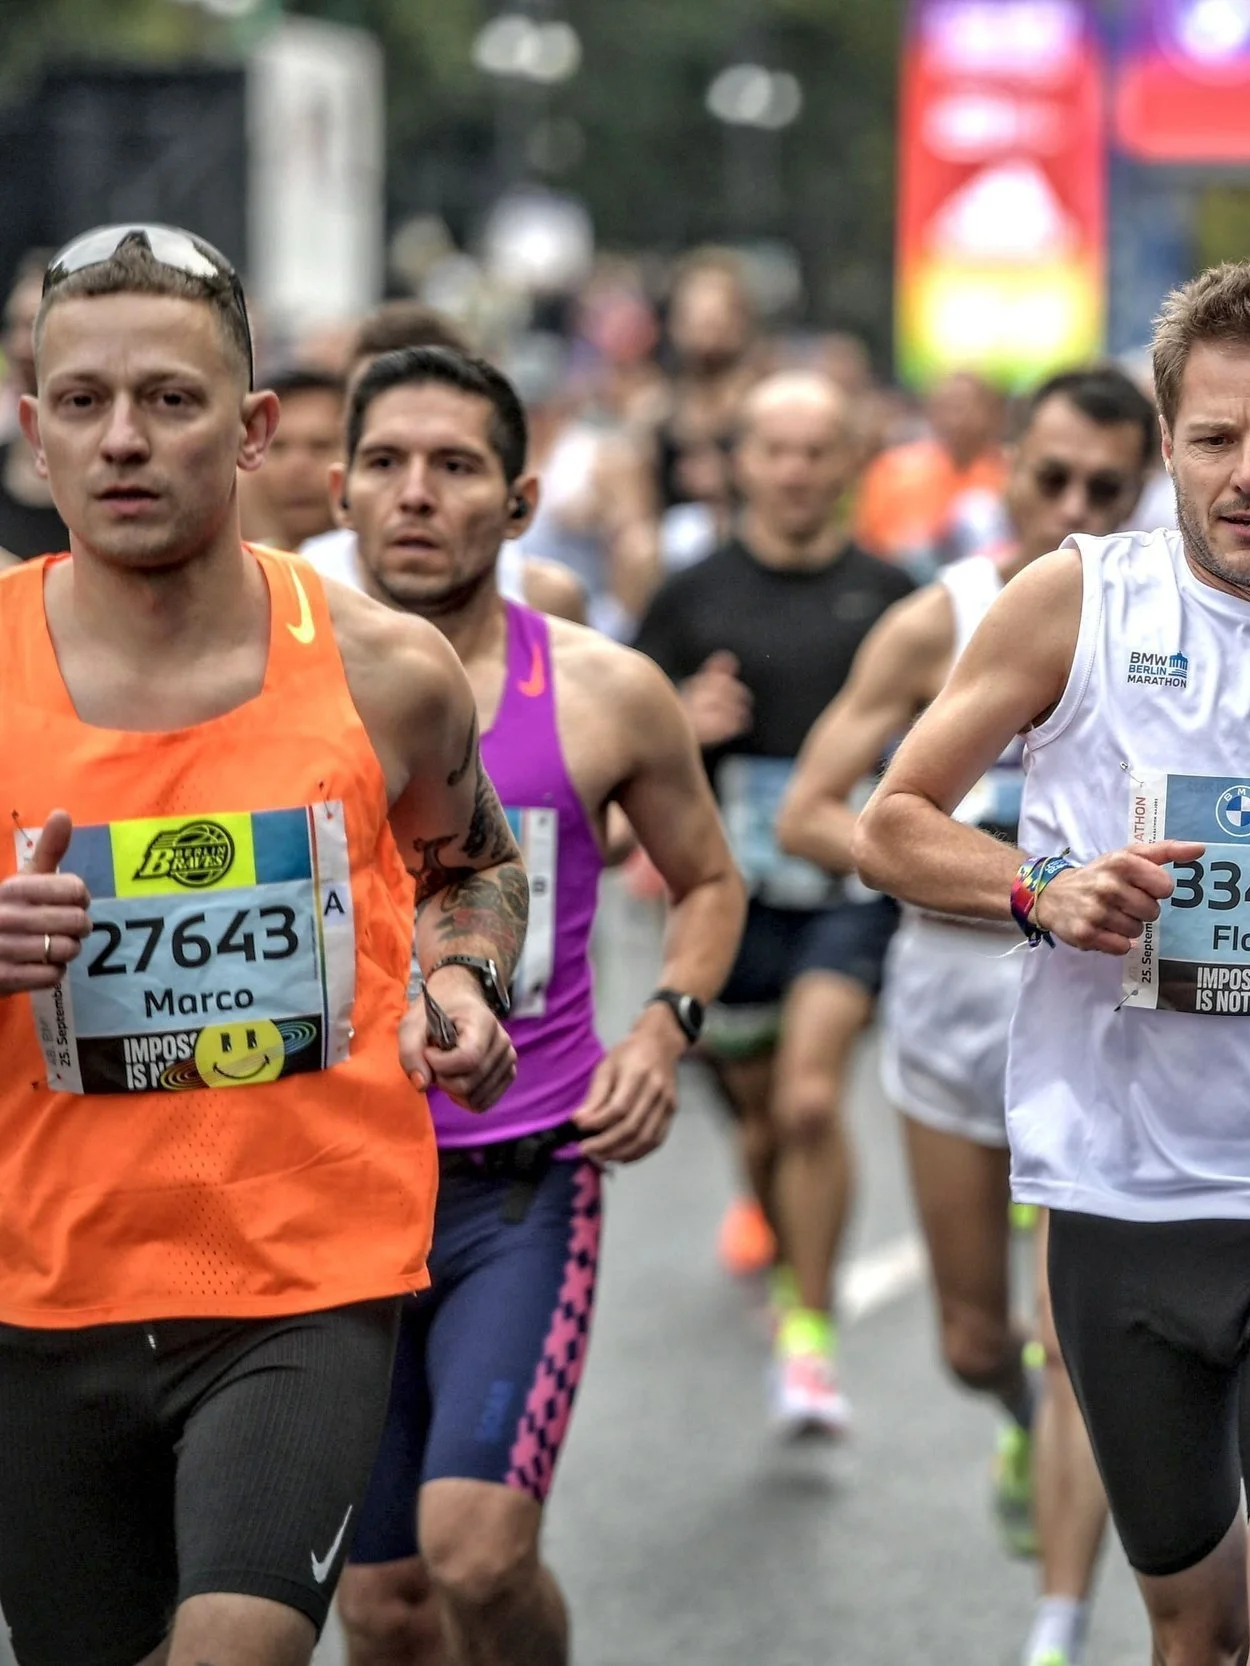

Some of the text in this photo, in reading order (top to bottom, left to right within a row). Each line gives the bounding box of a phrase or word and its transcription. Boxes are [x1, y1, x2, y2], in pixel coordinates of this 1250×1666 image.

[1128, 664, 1167, 676] BERLIN
[1130, 651, 1168, 666] BMW
[1127, 674, 1187, 689] MARATHON
[1133, 796, 1146, 844] ATHON
[324, 890, 345, 916] A
[88, 905, 299, 977] 27643
[1141, 922, 1154, 984] 25. Septem
[143, 988, 255, 1018] Marco
[1195, 989, 1213, 1011] IS
[53, 982, 71, 1067] 25. Septembe
[126, 1063, 148, 1090] IS
